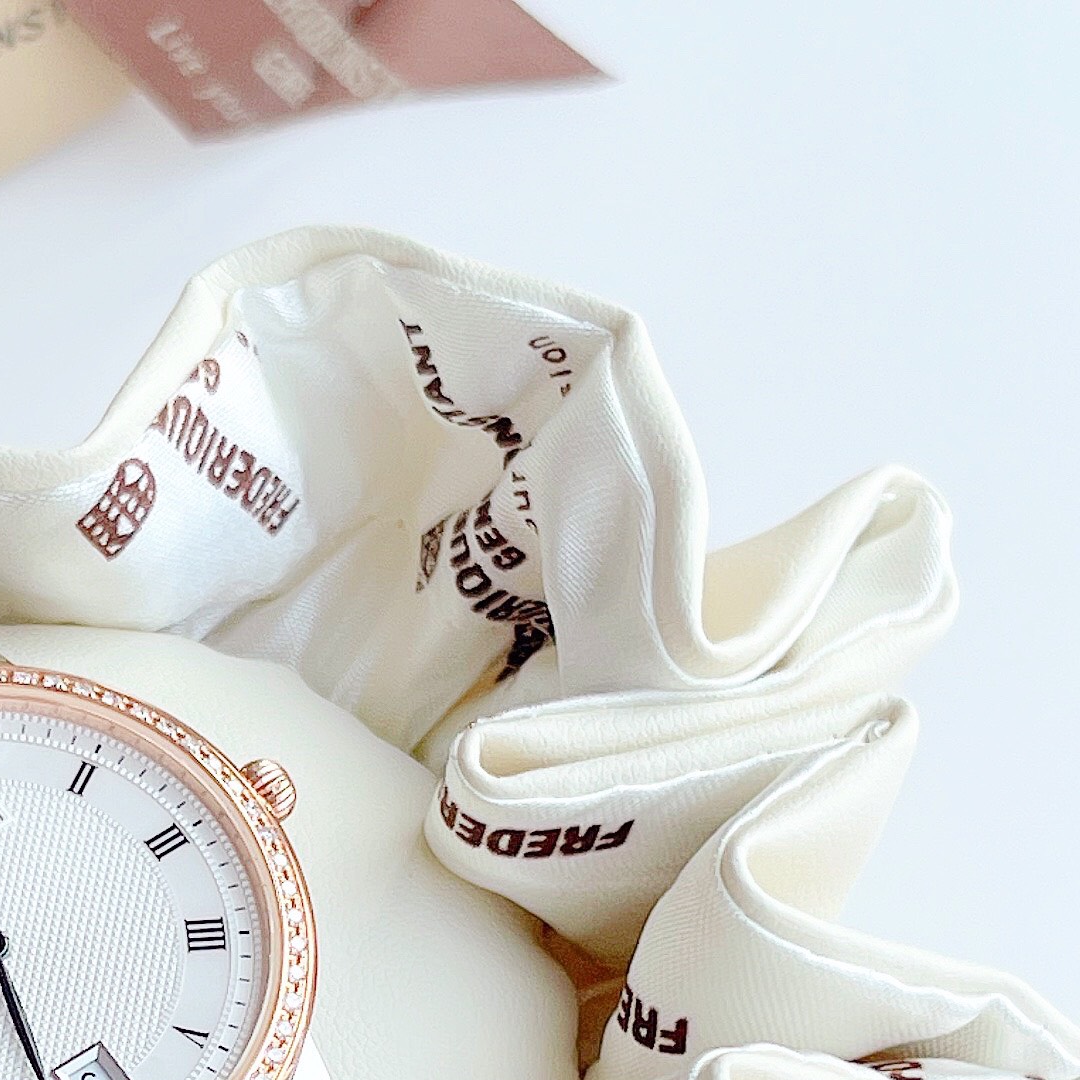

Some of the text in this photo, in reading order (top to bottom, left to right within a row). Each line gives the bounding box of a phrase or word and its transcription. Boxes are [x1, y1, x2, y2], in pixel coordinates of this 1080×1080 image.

[66, 760, 98, 796] II
[143, 822, 191, 862] III
[172, 1025, 210, 1050] V
